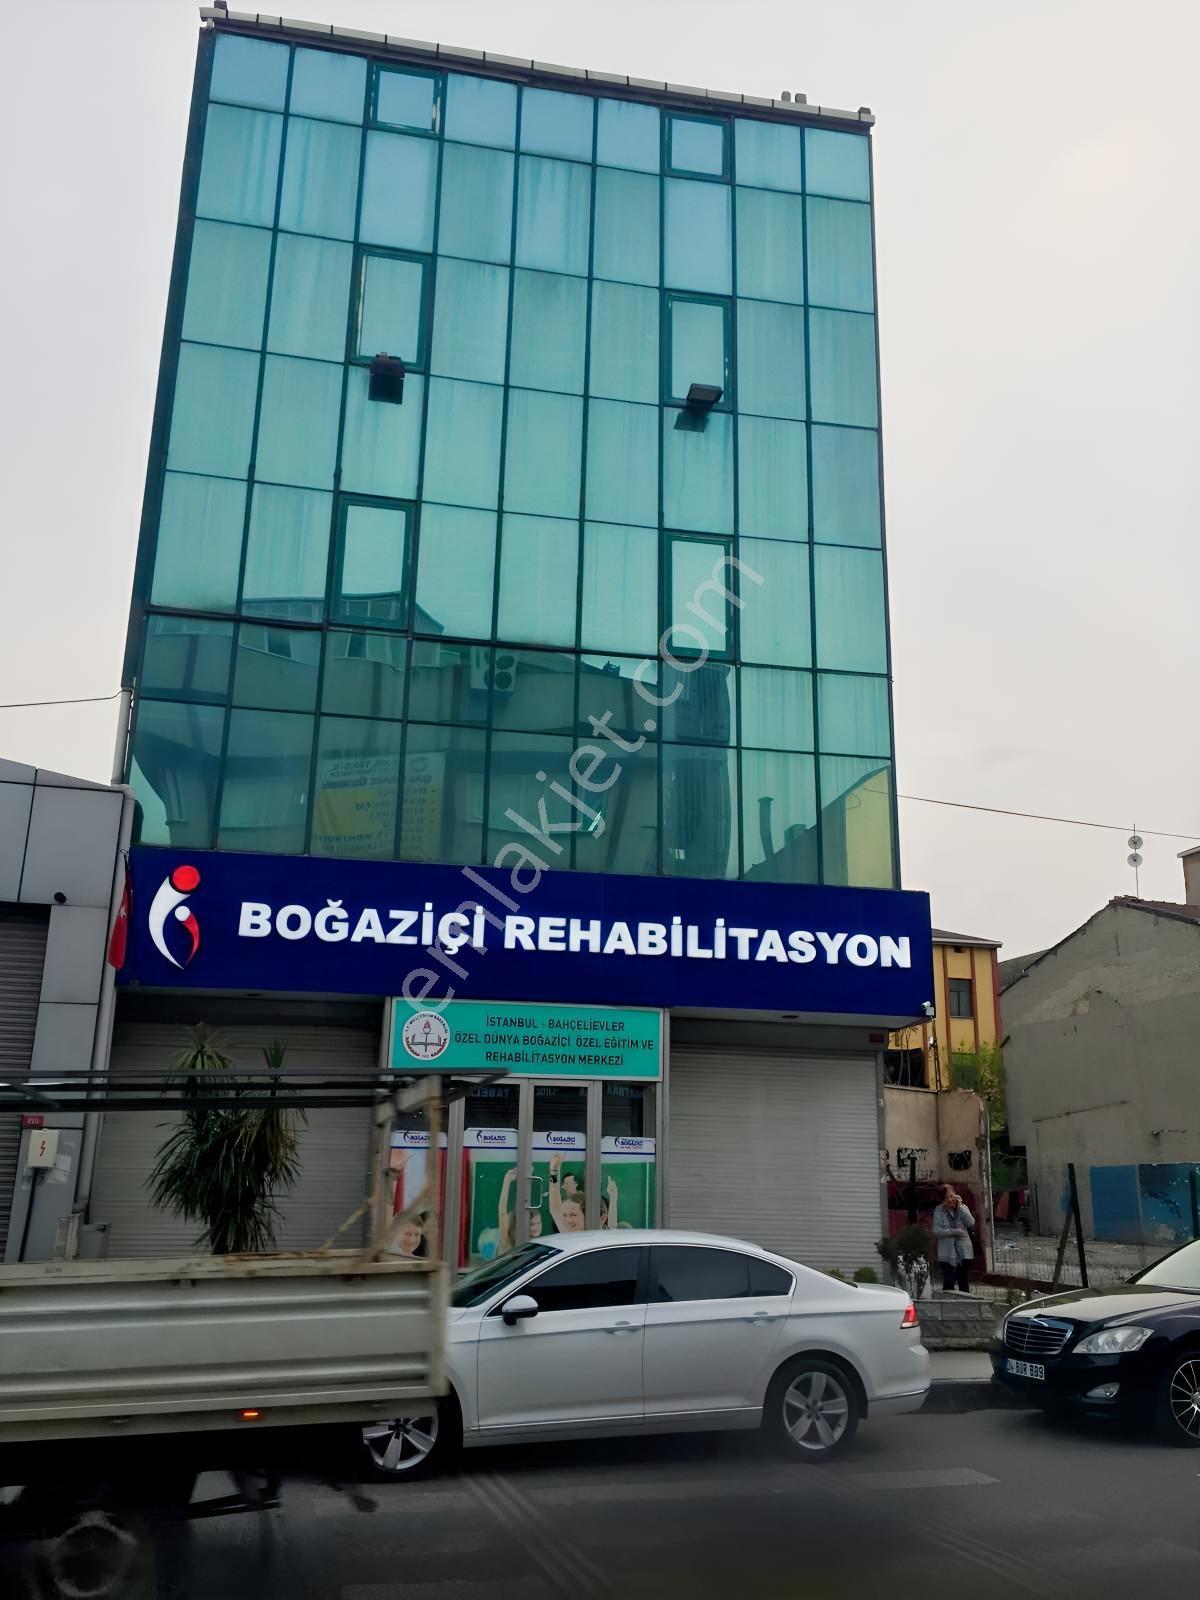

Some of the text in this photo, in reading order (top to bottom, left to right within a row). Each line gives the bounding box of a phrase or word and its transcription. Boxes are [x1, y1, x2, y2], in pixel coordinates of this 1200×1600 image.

[238, 899, 911, 968] BOĞAZİÇİ REHABİLİTASYON
[486, 1014, 538, 1028] İSTANBUL
[548, 1018, 625, 1032] BAHÇELİEVLER
[454, 1030, 654, 1050] ÖZEL DÜNYA BOĞAZİÇİ ÖZEL EĞİTİM VE
[486, 1050, 624, 1066] REHABİLİTASYON MERKEZİ
